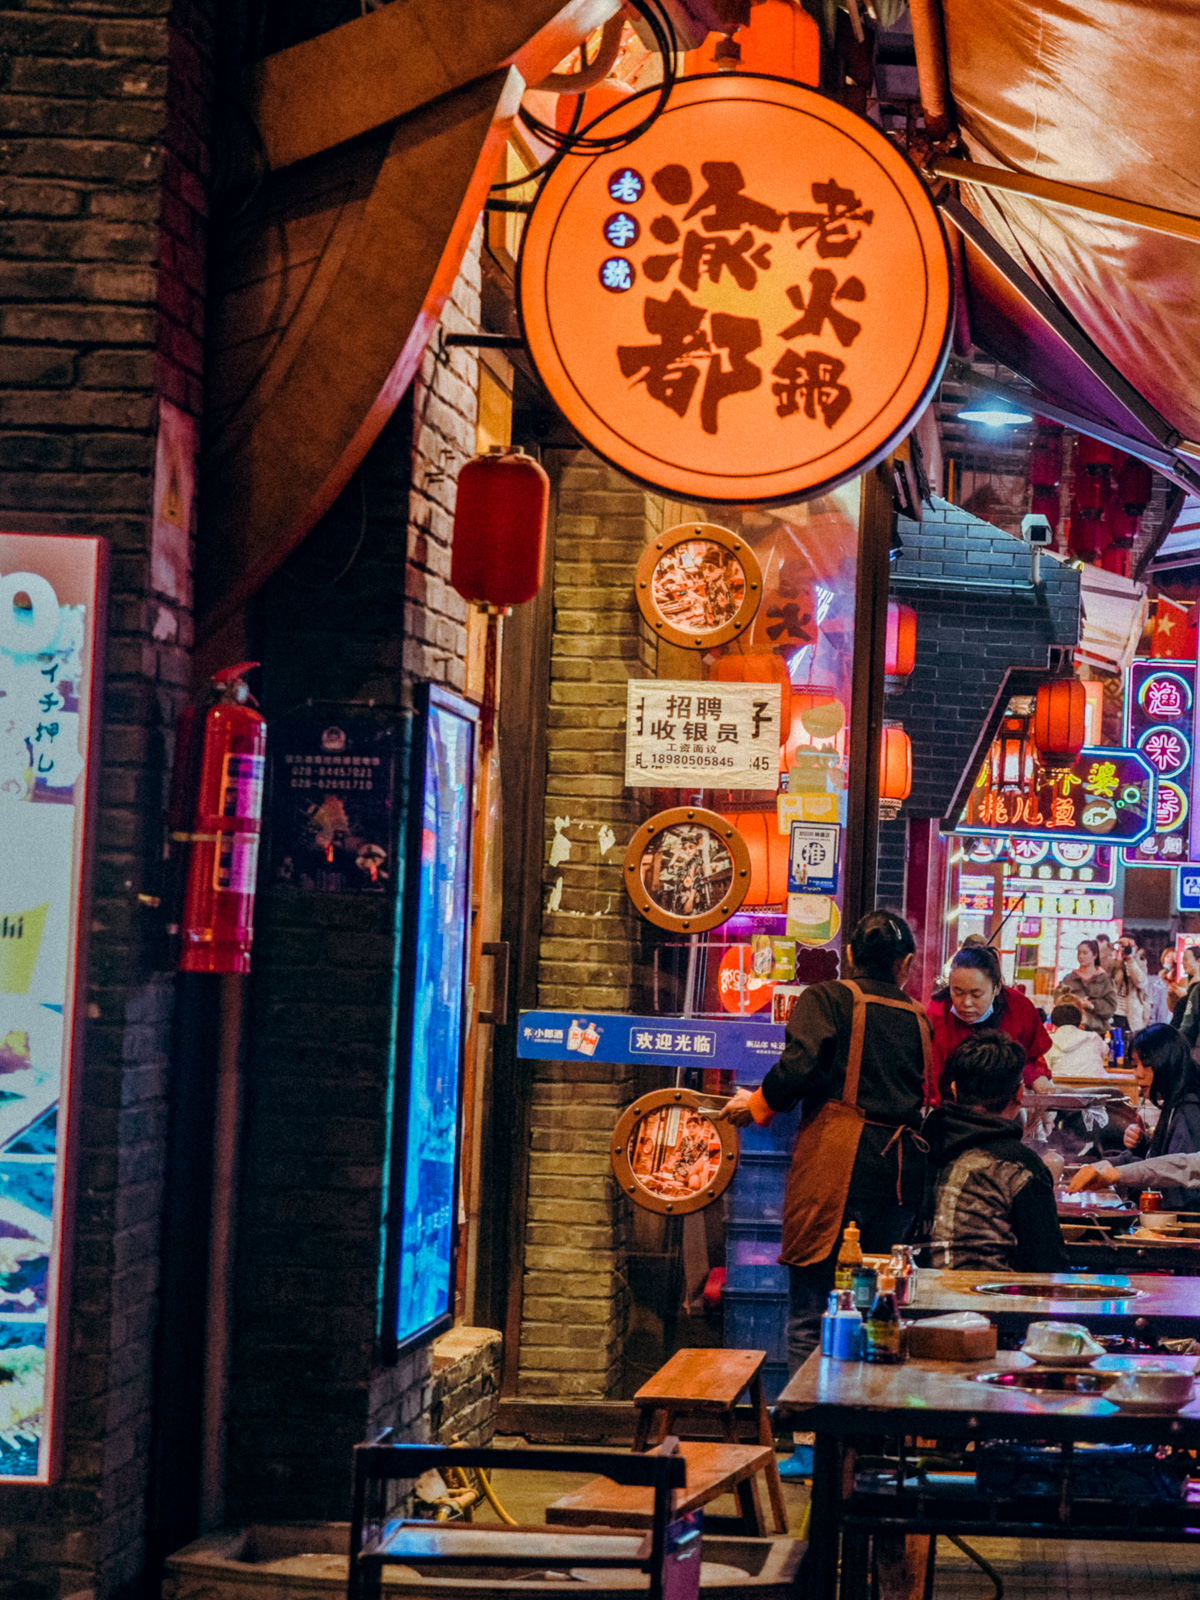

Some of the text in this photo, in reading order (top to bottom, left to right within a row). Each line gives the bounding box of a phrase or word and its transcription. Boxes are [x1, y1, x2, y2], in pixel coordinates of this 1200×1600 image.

[602, 171, 641, 289] 老字號
[772, 178, 874, 429] 老火鍋
[666, 694, 722, 721] 招聘
[650, 720, 739, 744] 收银员
[652, 754, 734, 767] 18980505845
[666, 743, 717, 754] 工资面议
[636, 1032, 711, 1053] 欢迎光临
